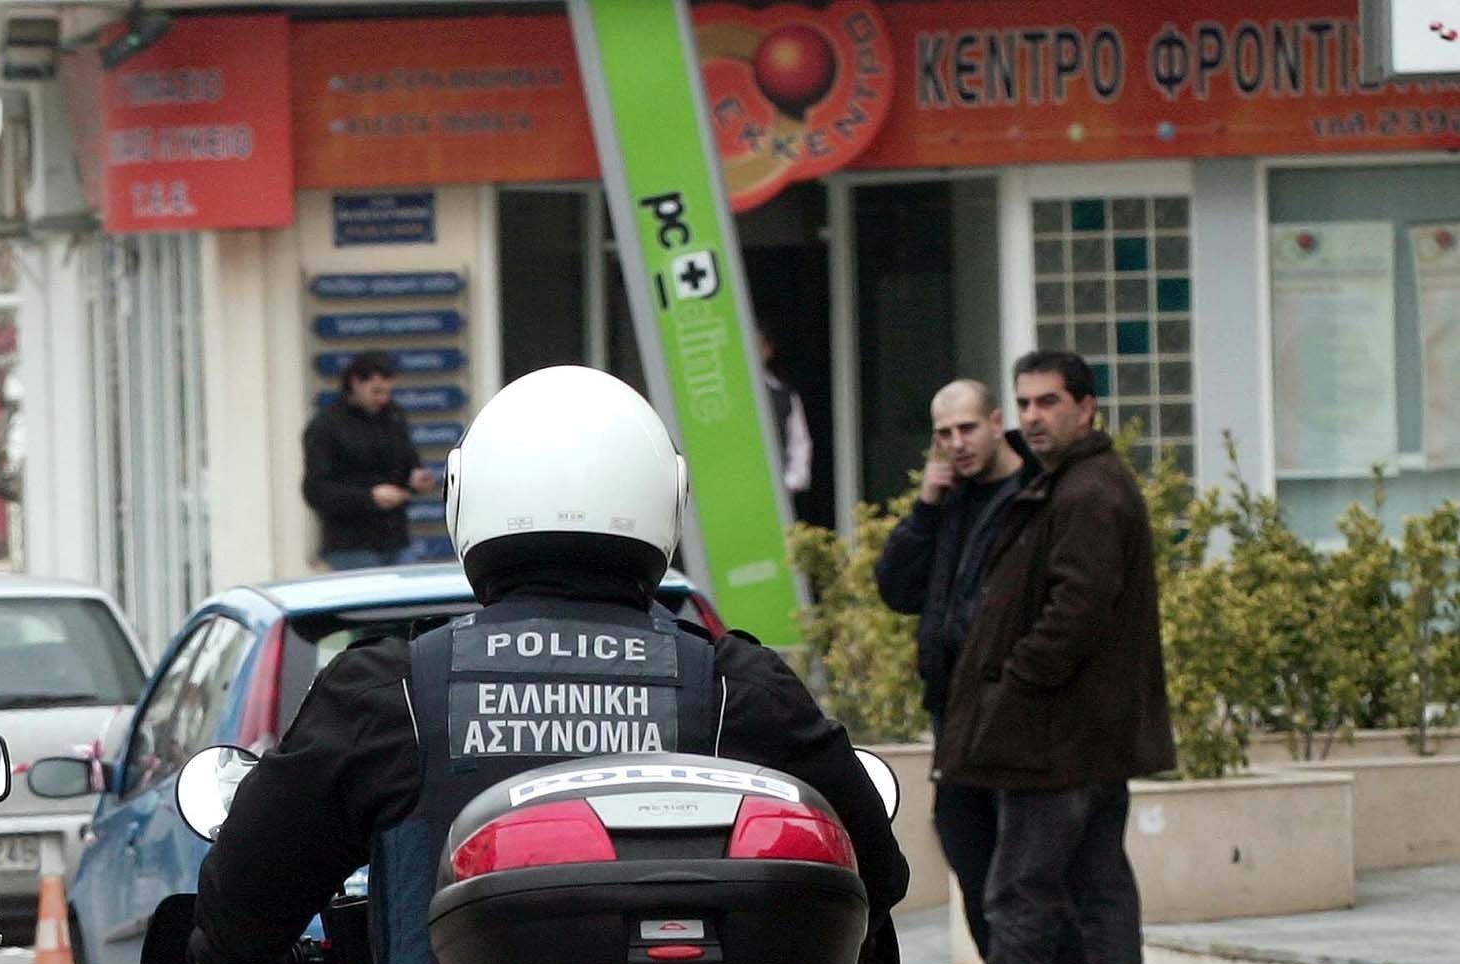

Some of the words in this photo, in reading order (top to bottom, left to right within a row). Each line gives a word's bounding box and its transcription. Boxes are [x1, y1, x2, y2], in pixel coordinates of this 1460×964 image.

[917, 27, 1123, 108] ΚΕΝΤΡΟ
[1149, 20, 1382, 101] ΦΡΟΝΤΙ
[640, 192, 690, 249] pc
[486, 631, 647, 662] POLICE
[478, 682, 650, 717] ΕΛΛΗΝΙΚΗ
[462, 719, 664, 754] ΑΣΤΥΝΟΜΙΑ
[518, 768, 792, 798] POLICE
